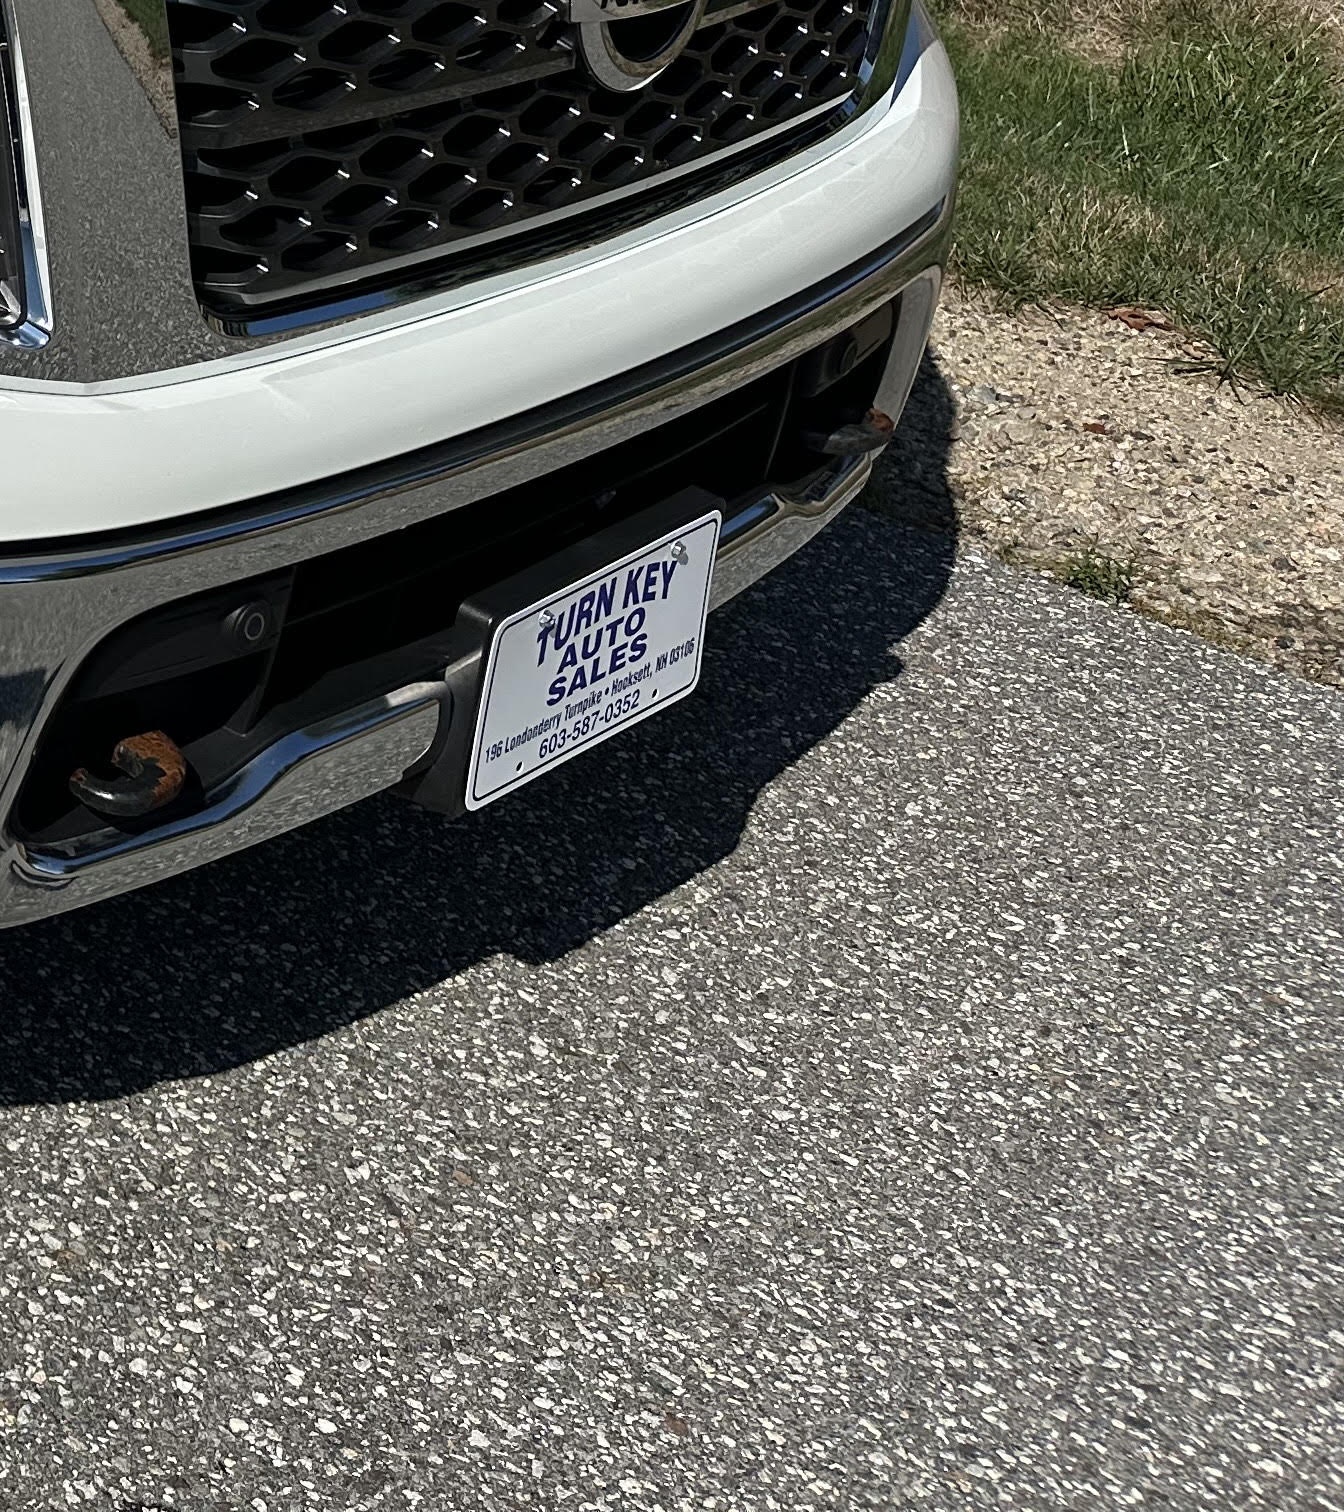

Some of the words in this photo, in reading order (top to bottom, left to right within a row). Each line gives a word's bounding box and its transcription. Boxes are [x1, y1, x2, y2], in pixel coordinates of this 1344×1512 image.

[537, 577, 617, 667] TURN
[622, 560, 678, 609] KEY
[556, 607, 646, 675] AUTO
[546, 633, 647, 706] SALES
[485, 740, 503, 764] 196
[505, 713, 561, 753] Londonderry
[564, 690, 602, 722] Turnpike
[538, 689, 640, 758] 603-587-0352
